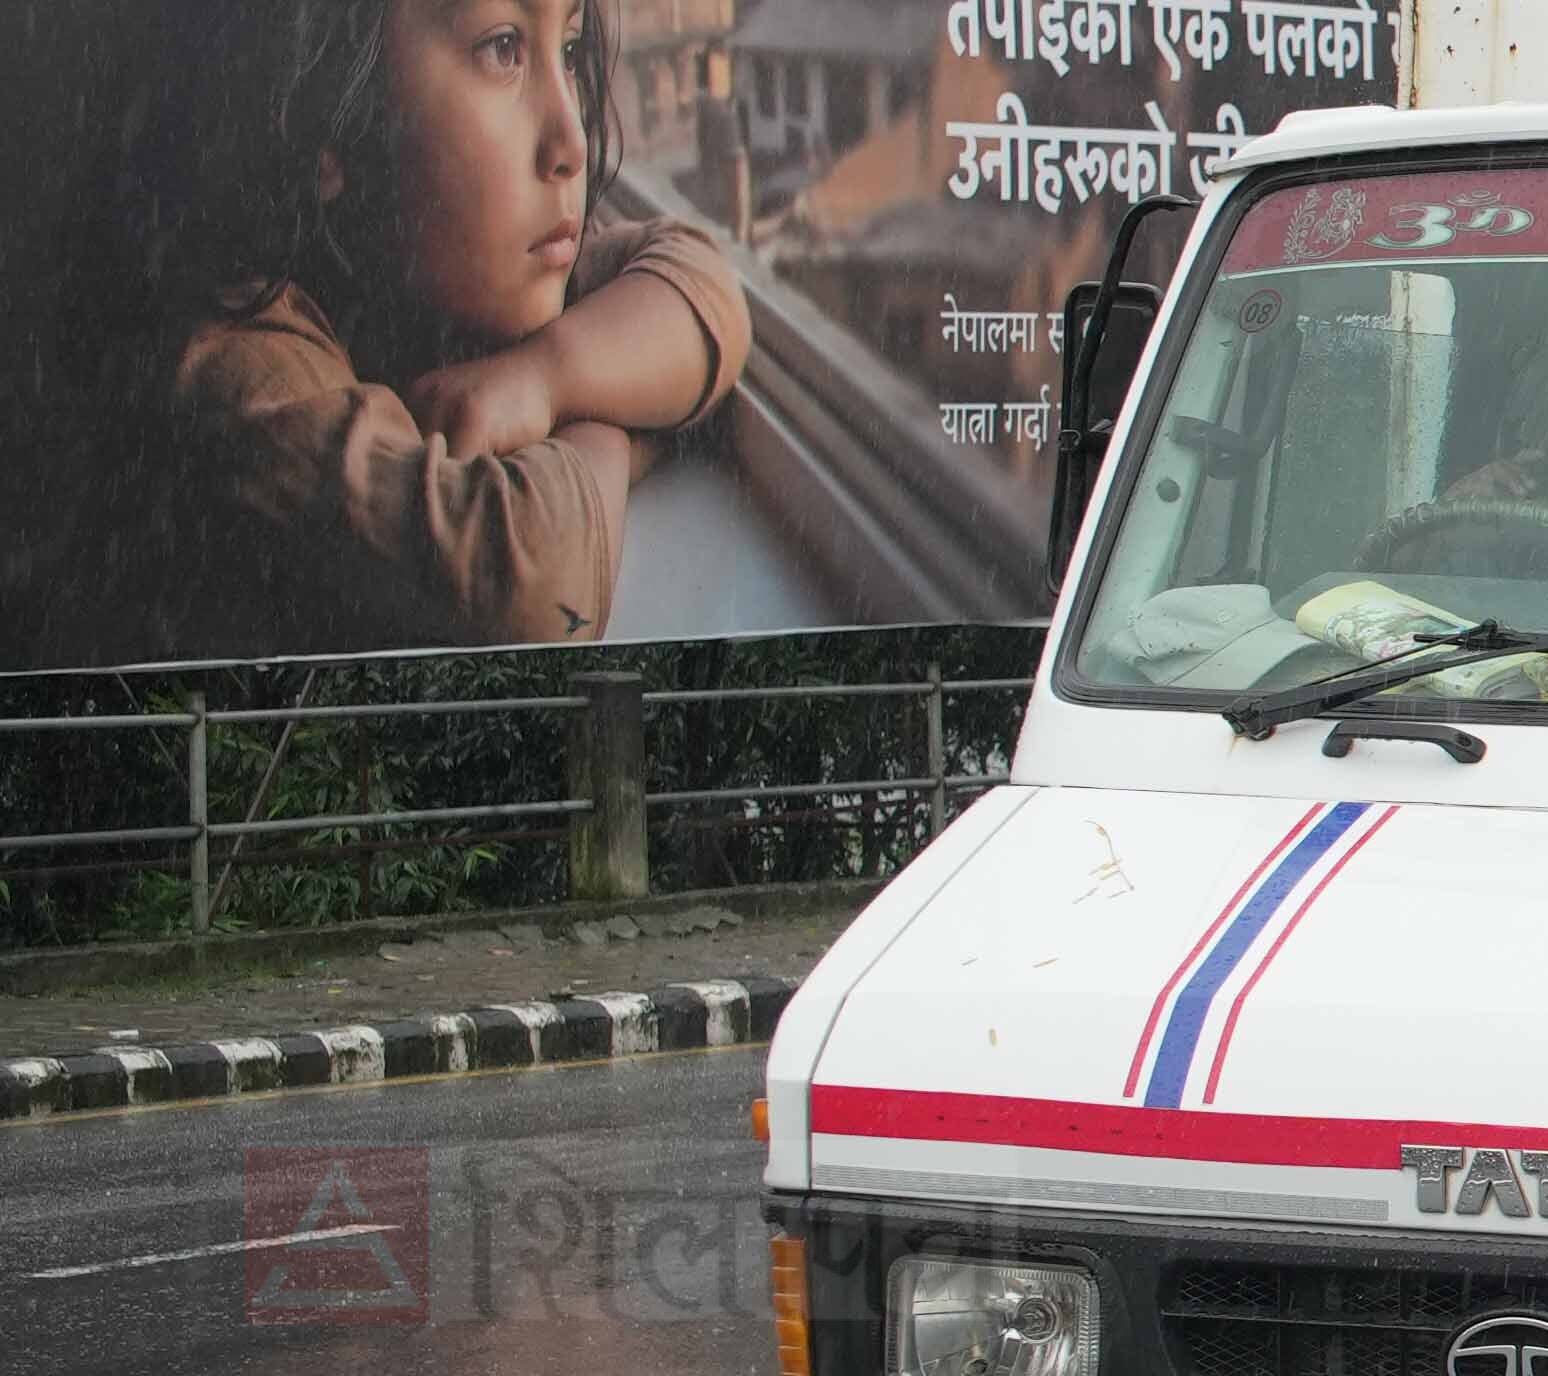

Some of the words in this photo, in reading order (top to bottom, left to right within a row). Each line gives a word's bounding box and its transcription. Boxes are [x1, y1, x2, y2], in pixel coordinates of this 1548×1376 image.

[940, 293, 1039, 353] नेपालमा
[939, 403, 998, 444] यात्रा
[1003, 384, 1051, 451] गर्दा
